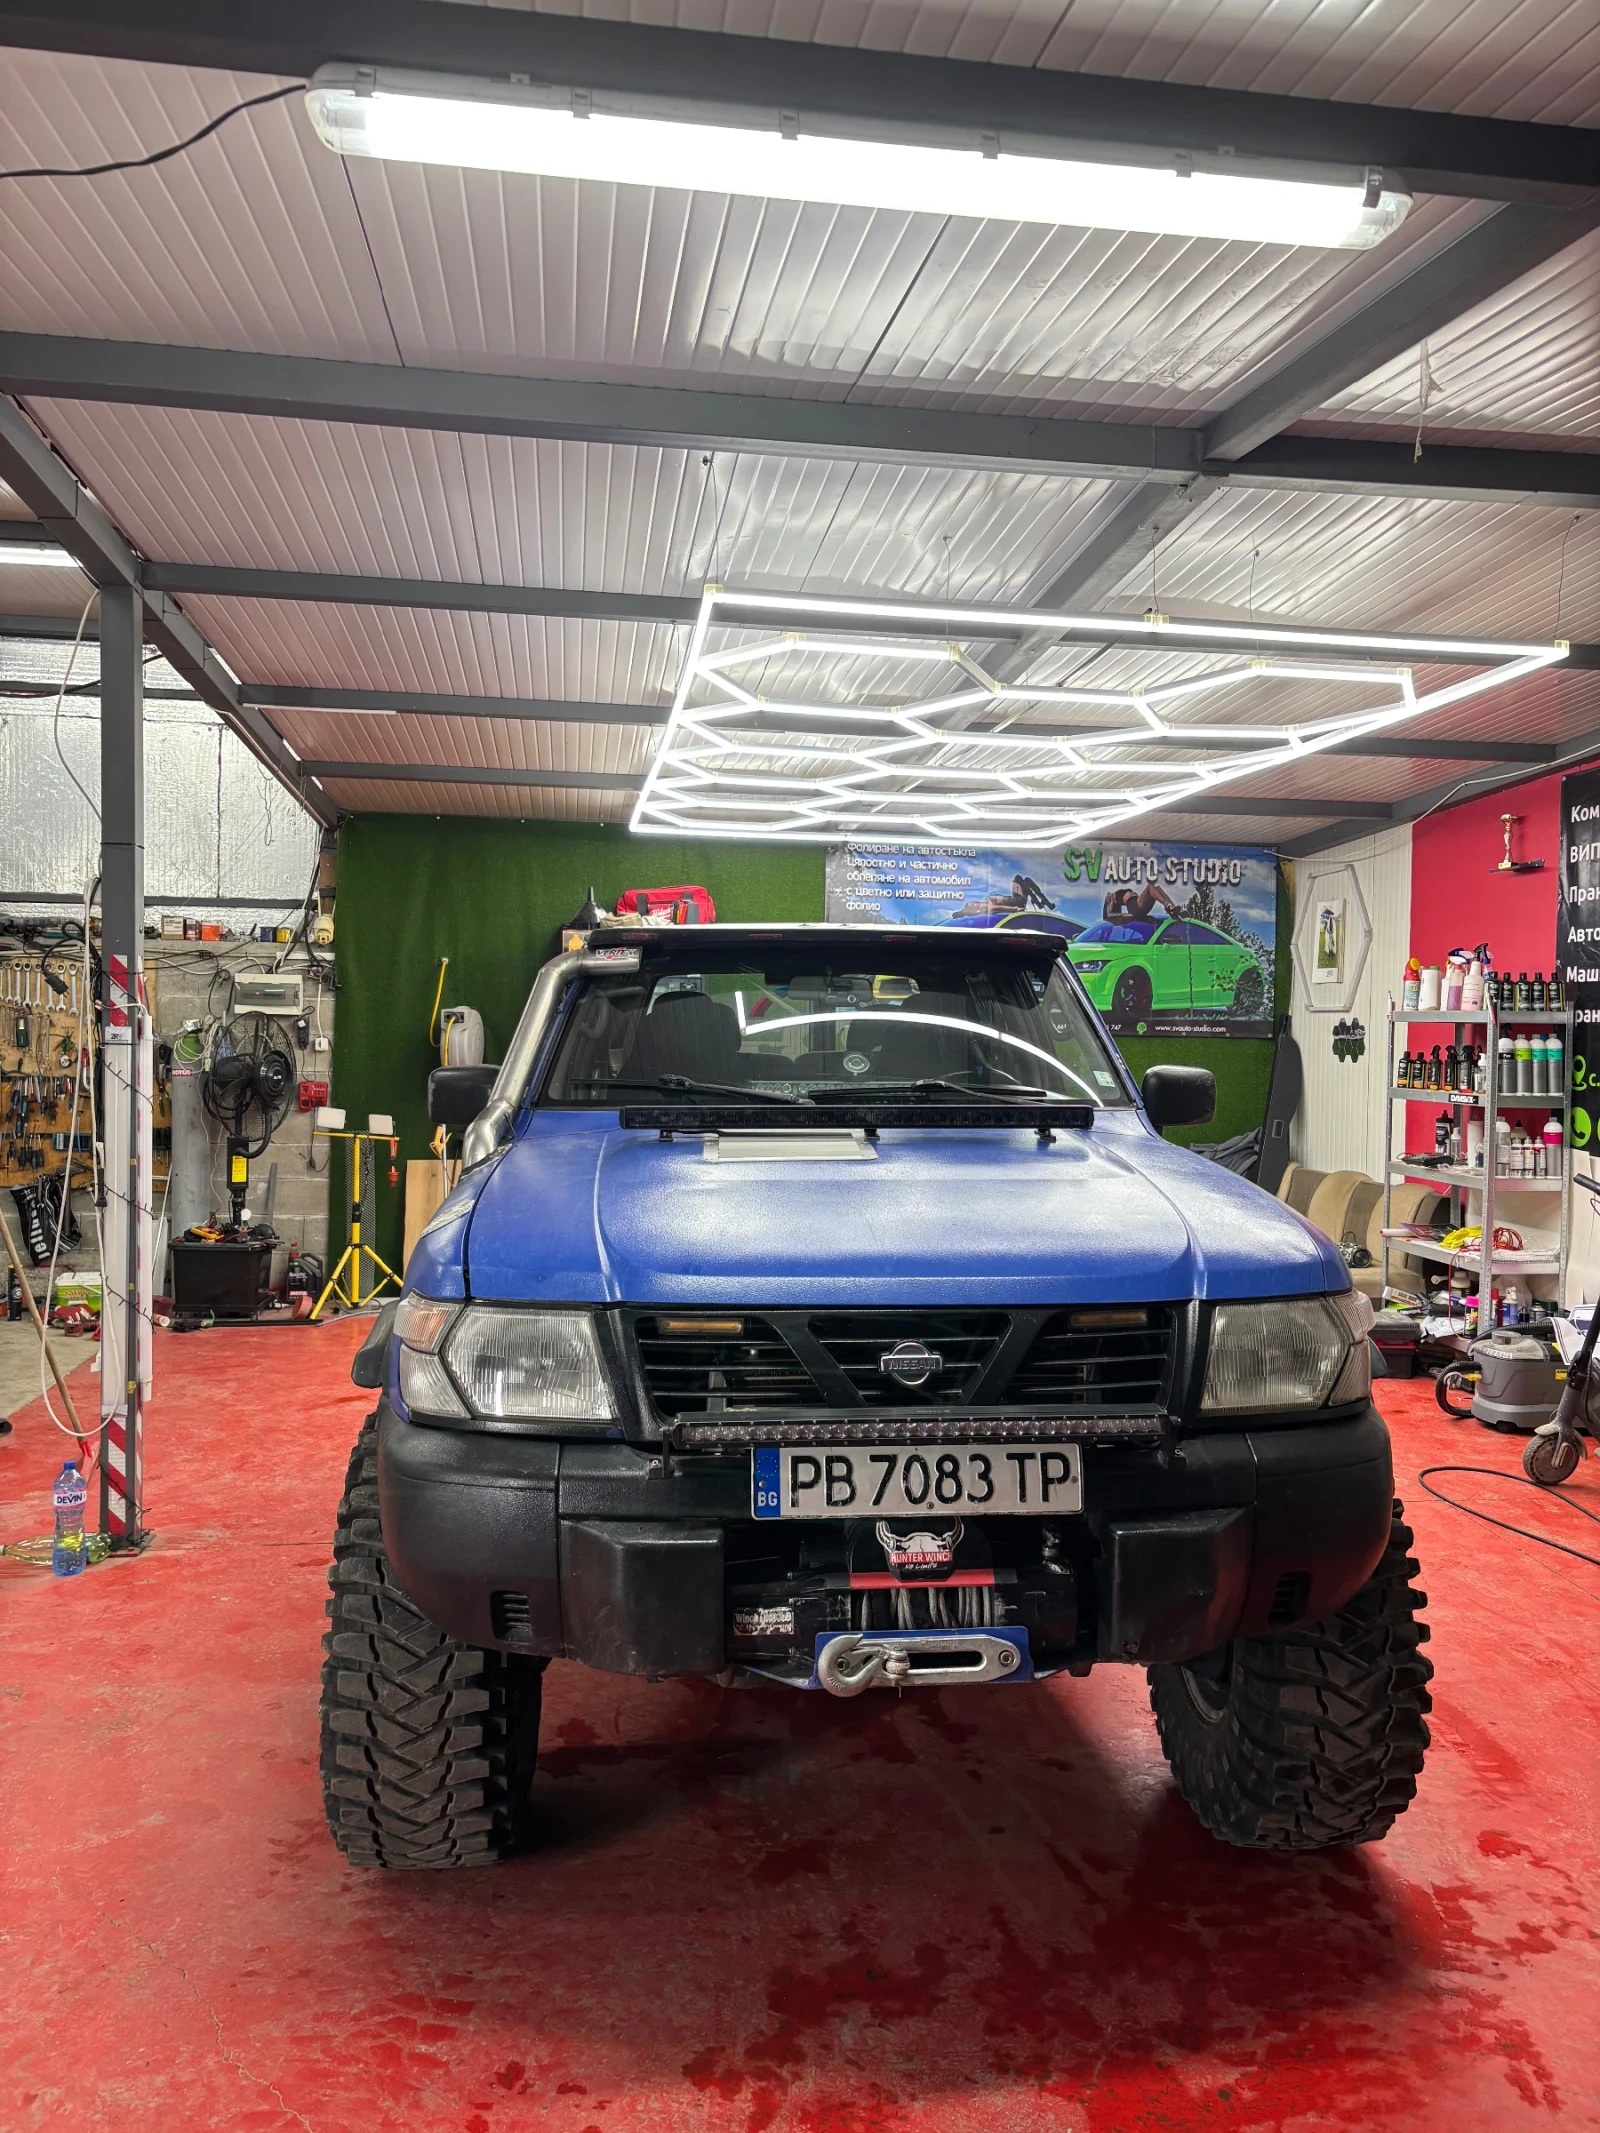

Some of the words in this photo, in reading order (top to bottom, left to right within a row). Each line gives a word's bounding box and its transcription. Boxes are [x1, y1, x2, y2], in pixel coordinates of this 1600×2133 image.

[847, 842, 899, 855] Фолиране
[903, 845, 914, 854] на
[918, 847, 976, 857] автостъкла
[846, 857, 895, 869] Цялостно
[900, 859, 907, 869] и
[910, 861, 958, 871] частично
[1064, 847, 1103, 880] SV
[1104, 855, 1159, 881] AUTO
[1165, 857, 1242, 884] STUDIO
[846, 872, 895, 882] облепяне
[900, 875, 911, 883] на
[914, 875, 971, 885] автомобил
[855, 888, 892, 898] цветно
[896, 890, 915, 898] или
[918, 891, 964, 900] защитно
[846, 901, 881, 912] фолио
[1566, 966, 1600, 983] Маш
[1575, 1009, 1600, 1027] ран
[888, 1359, 936, 1370] NISSAN
[788, 1455, 857, 1508] PB
[869, 1453, 996, 1506] 7083
[1005, 1452, 1071, 1504] TP
[57, 1493, 82, 1504] DEVIN
[757, 1491, 778, 1507] BG
[890, 1552, 923, 1564] HUNTER
[925, 1551, 953, 1563] WINCH
